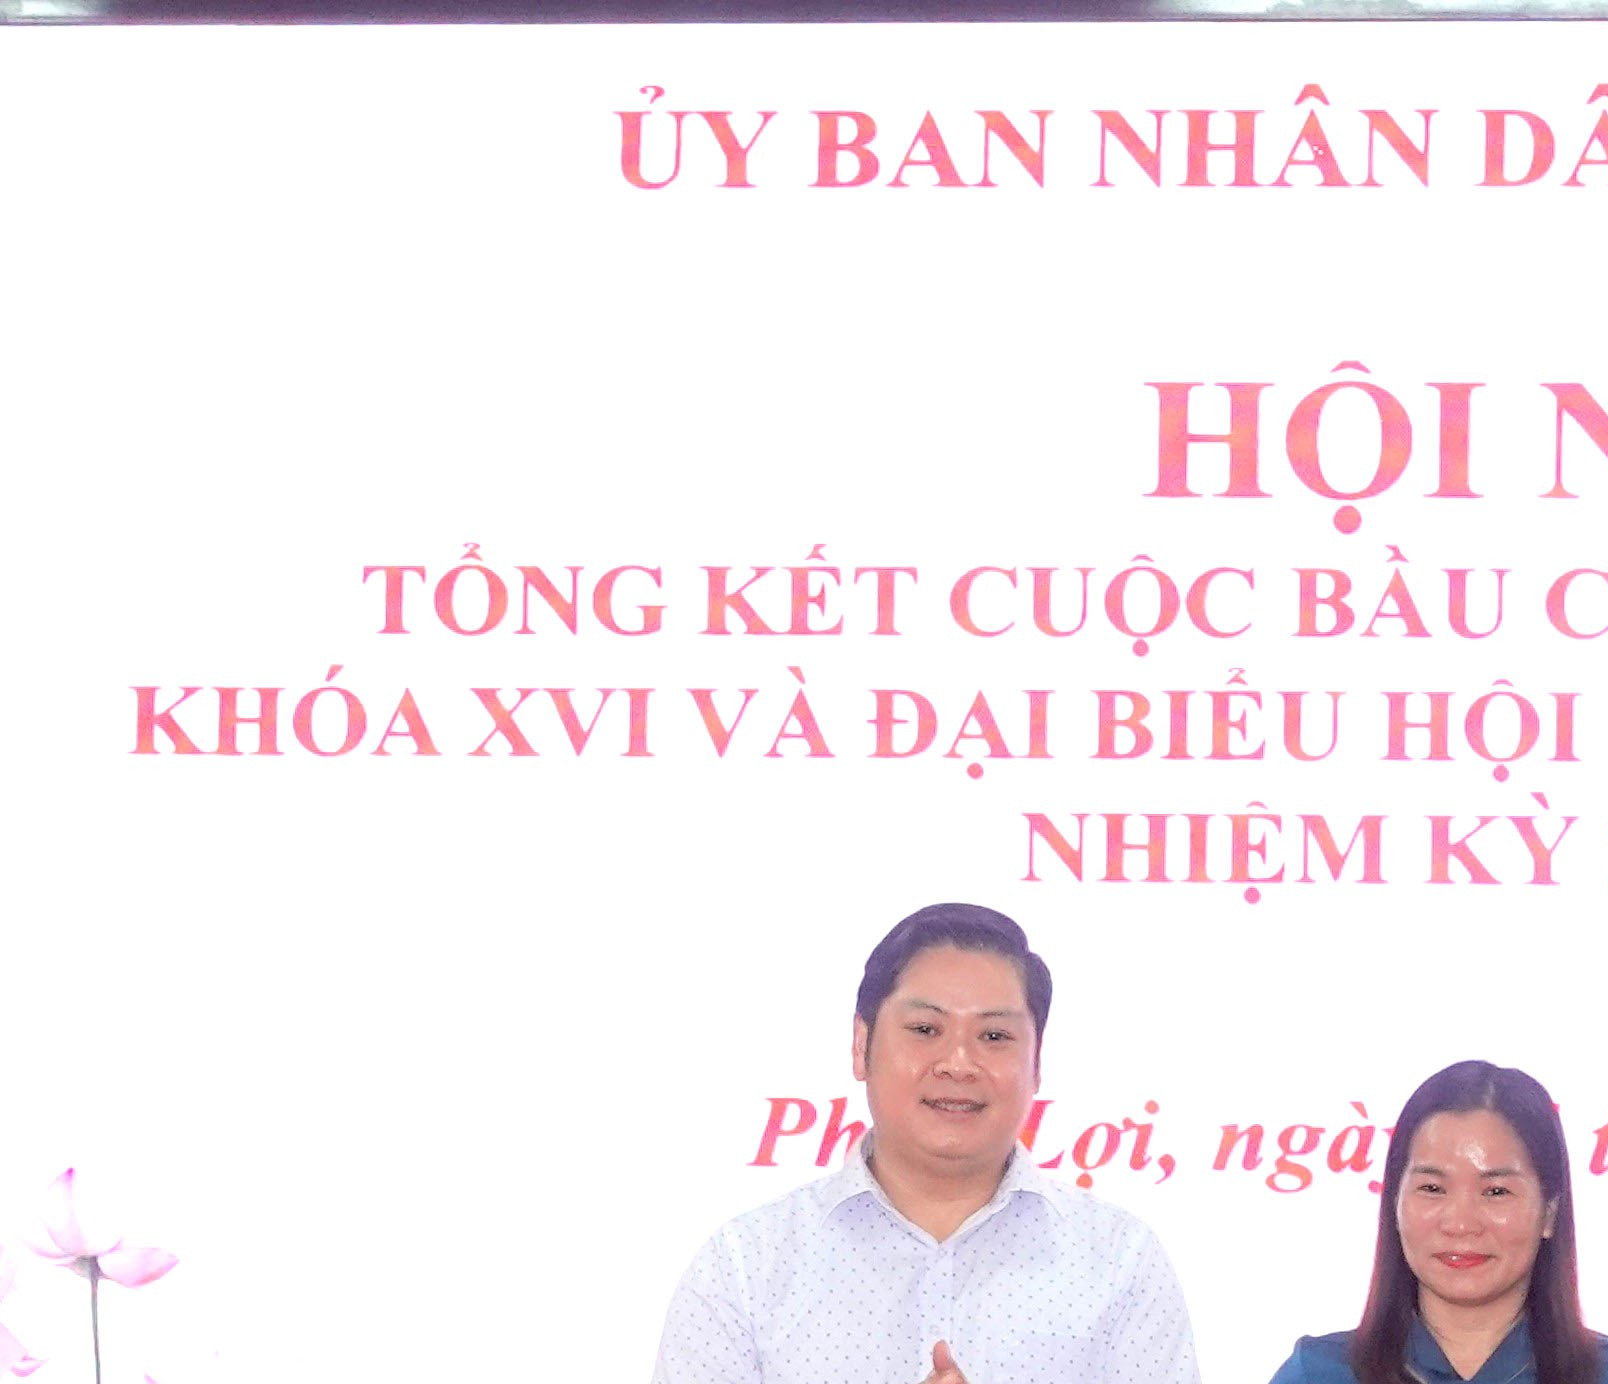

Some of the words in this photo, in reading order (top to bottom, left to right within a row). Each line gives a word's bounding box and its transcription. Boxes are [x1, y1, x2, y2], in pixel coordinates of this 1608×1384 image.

[616, 85, 777, 190] ỦY
[810, 110, 1053, 189] BAN
[1090, 83, 1439, 188] NHÂN
[1144, 360, 1486, 535] HỘI
[363, 543, 667, 637] TỔNG
[699, 543, 918, 636] KẾT
[949, 554, 1256, 657] CUỘC
[1292, 545, 1511, 640] BẦU
[129, 665, 442, 757] KHÓA
[468, 687, 656, 758] XVI
[686, 666, 834, 759] VÀ
[867, 689, 1055, 780] ĐẠI
[1091, 668, 1346, 761] BIỂU
[1381, 678, 1581, 783] HỘI
[1021, 801, 1389, 905] NHIỆM
[1425, 791, 1579, 885] KỲ
[1017, 1099, 1177, 1185] Lợi,
